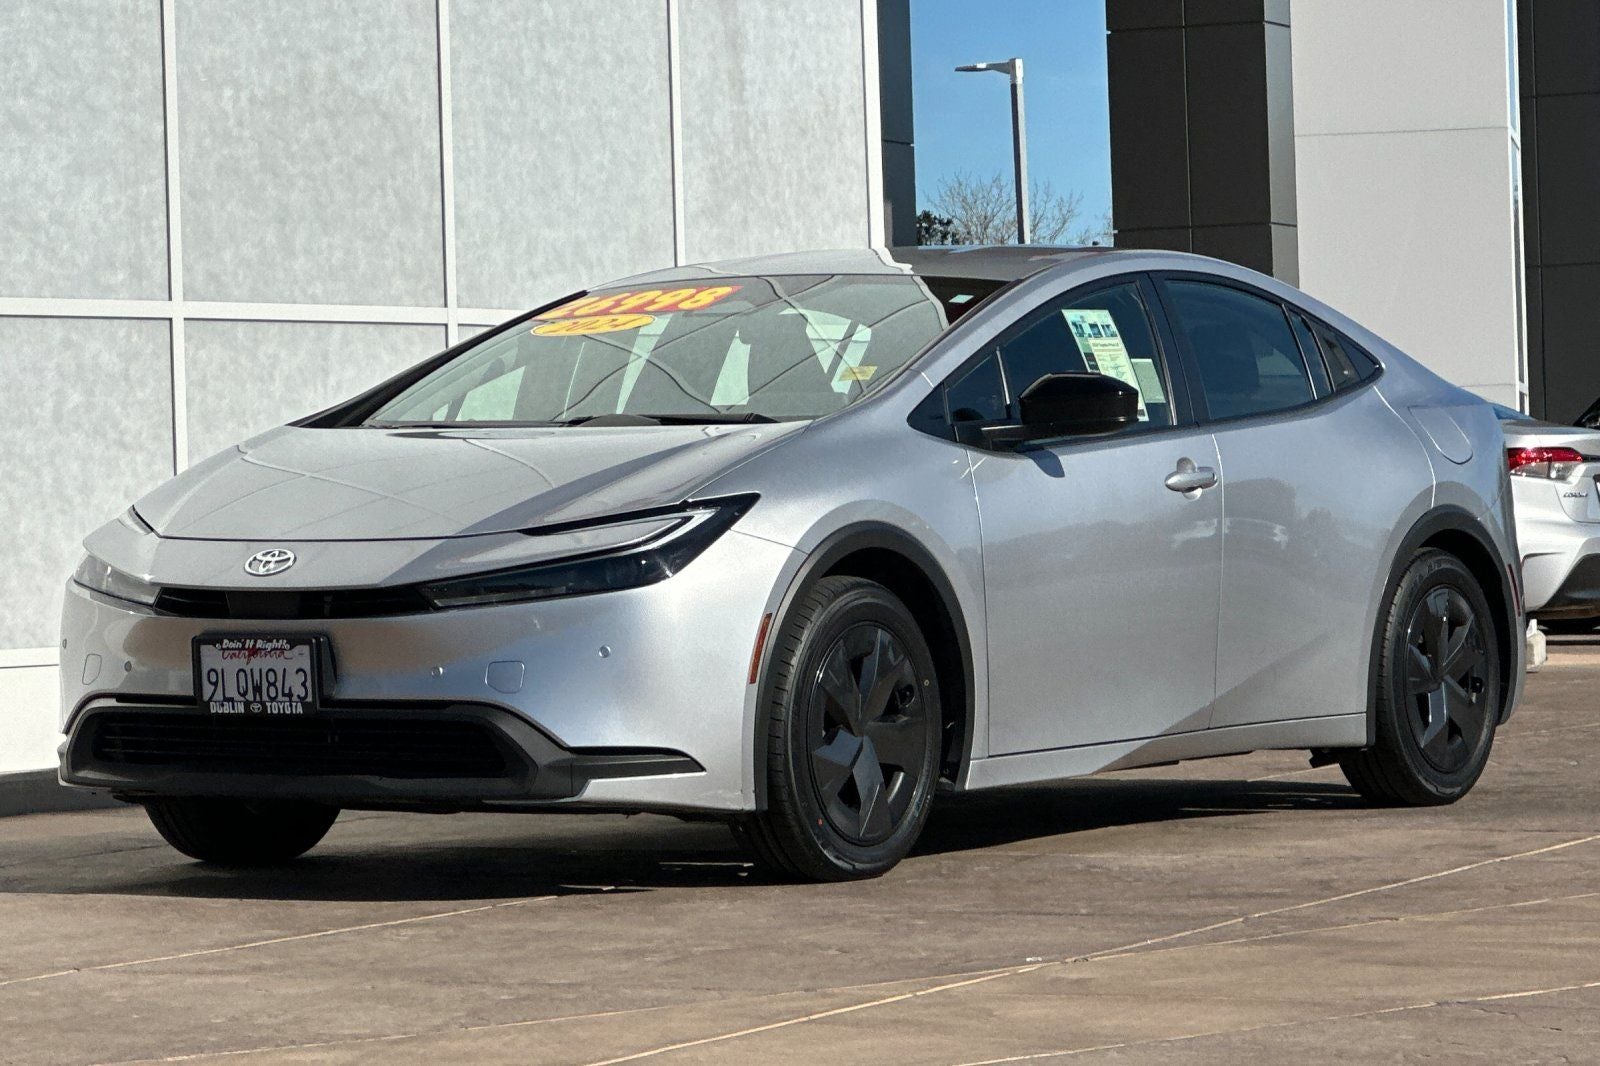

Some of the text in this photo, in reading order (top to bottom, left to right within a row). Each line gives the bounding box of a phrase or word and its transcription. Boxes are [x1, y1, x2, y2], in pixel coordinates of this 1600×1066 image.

[206, 667, 309, 701] 9LQW843
[210, 702, 303, 714] DUBLIN TOYOTA
